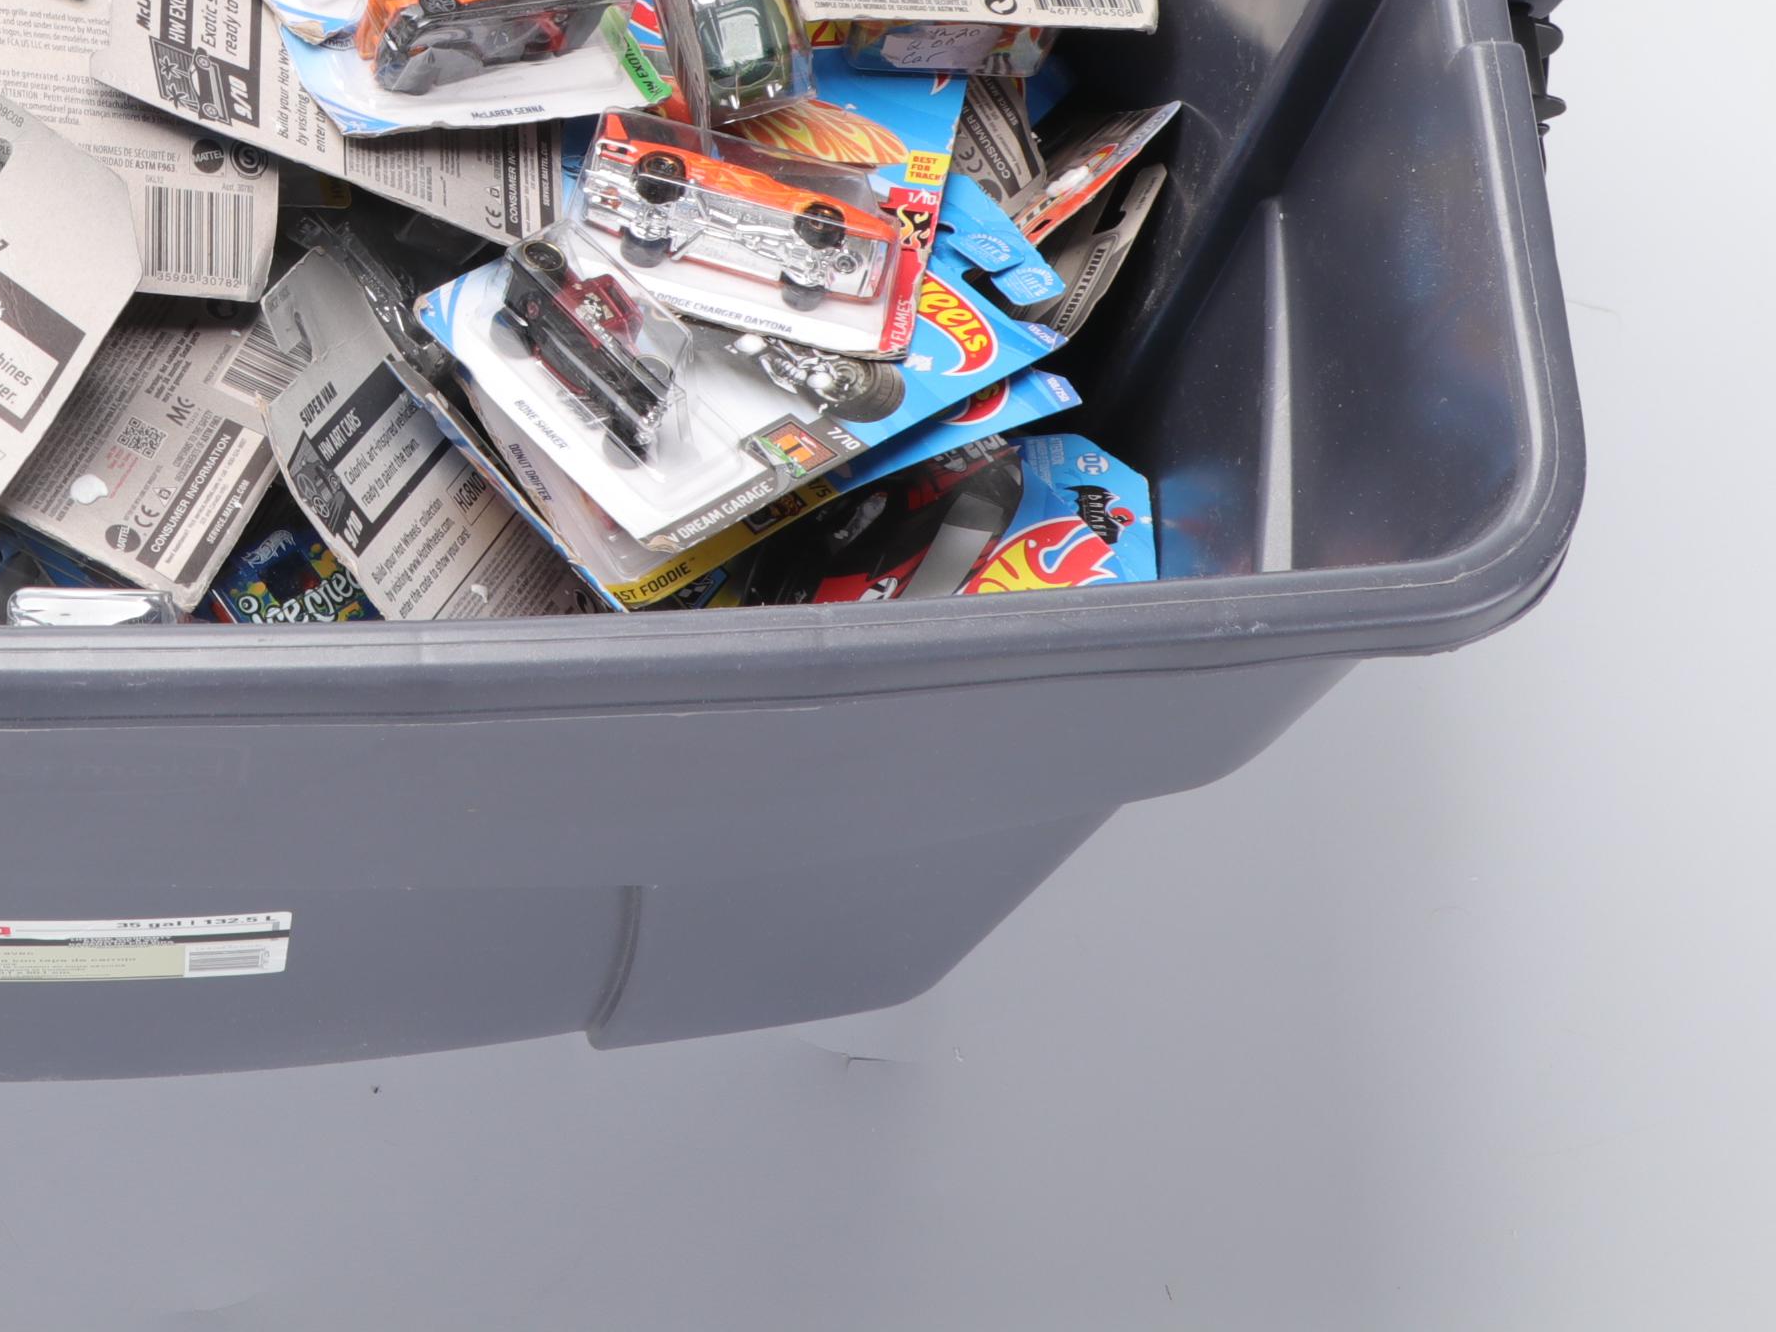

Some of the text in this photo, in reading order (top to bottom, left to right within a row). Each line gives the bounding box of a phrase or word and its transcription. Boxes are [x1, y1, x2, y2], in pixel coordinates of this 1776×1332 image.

[226, 0, 238, 14] to
[1049, 4, 1088, 17] 46775
[169, 20, 186, 42] HW
[202, 7, 217, 47] Exotic
[225, 18, 241, 55] ready
[471, 103, 544, 121] McLAREN SENNA
[194, 148, 223, 164] MATTEL
[157, 272, 239, 288] 35995 30782
[656, 293, 793, 334] DODGE CHARGER DAYTONA
[296, 380, 341, 428] SUPER VAN
[315, 409, 364, 461] HW ART CARS
[341, 398, 420, 486] Colorful, art-inspired vehicles
[829, 424, 860, 451] 7/10
[358, 437, 420, 508] ready to paint the town.
[503, 440, 558, 504] DONUT DRIFTER
[149, 432, 233, 554] CONSUMER INFORMATION
[677, 480, 773, 536] DREAM GARAGE
[110, 523, 136, 552] MATTEL
[149, 920, 182, 928] gal
